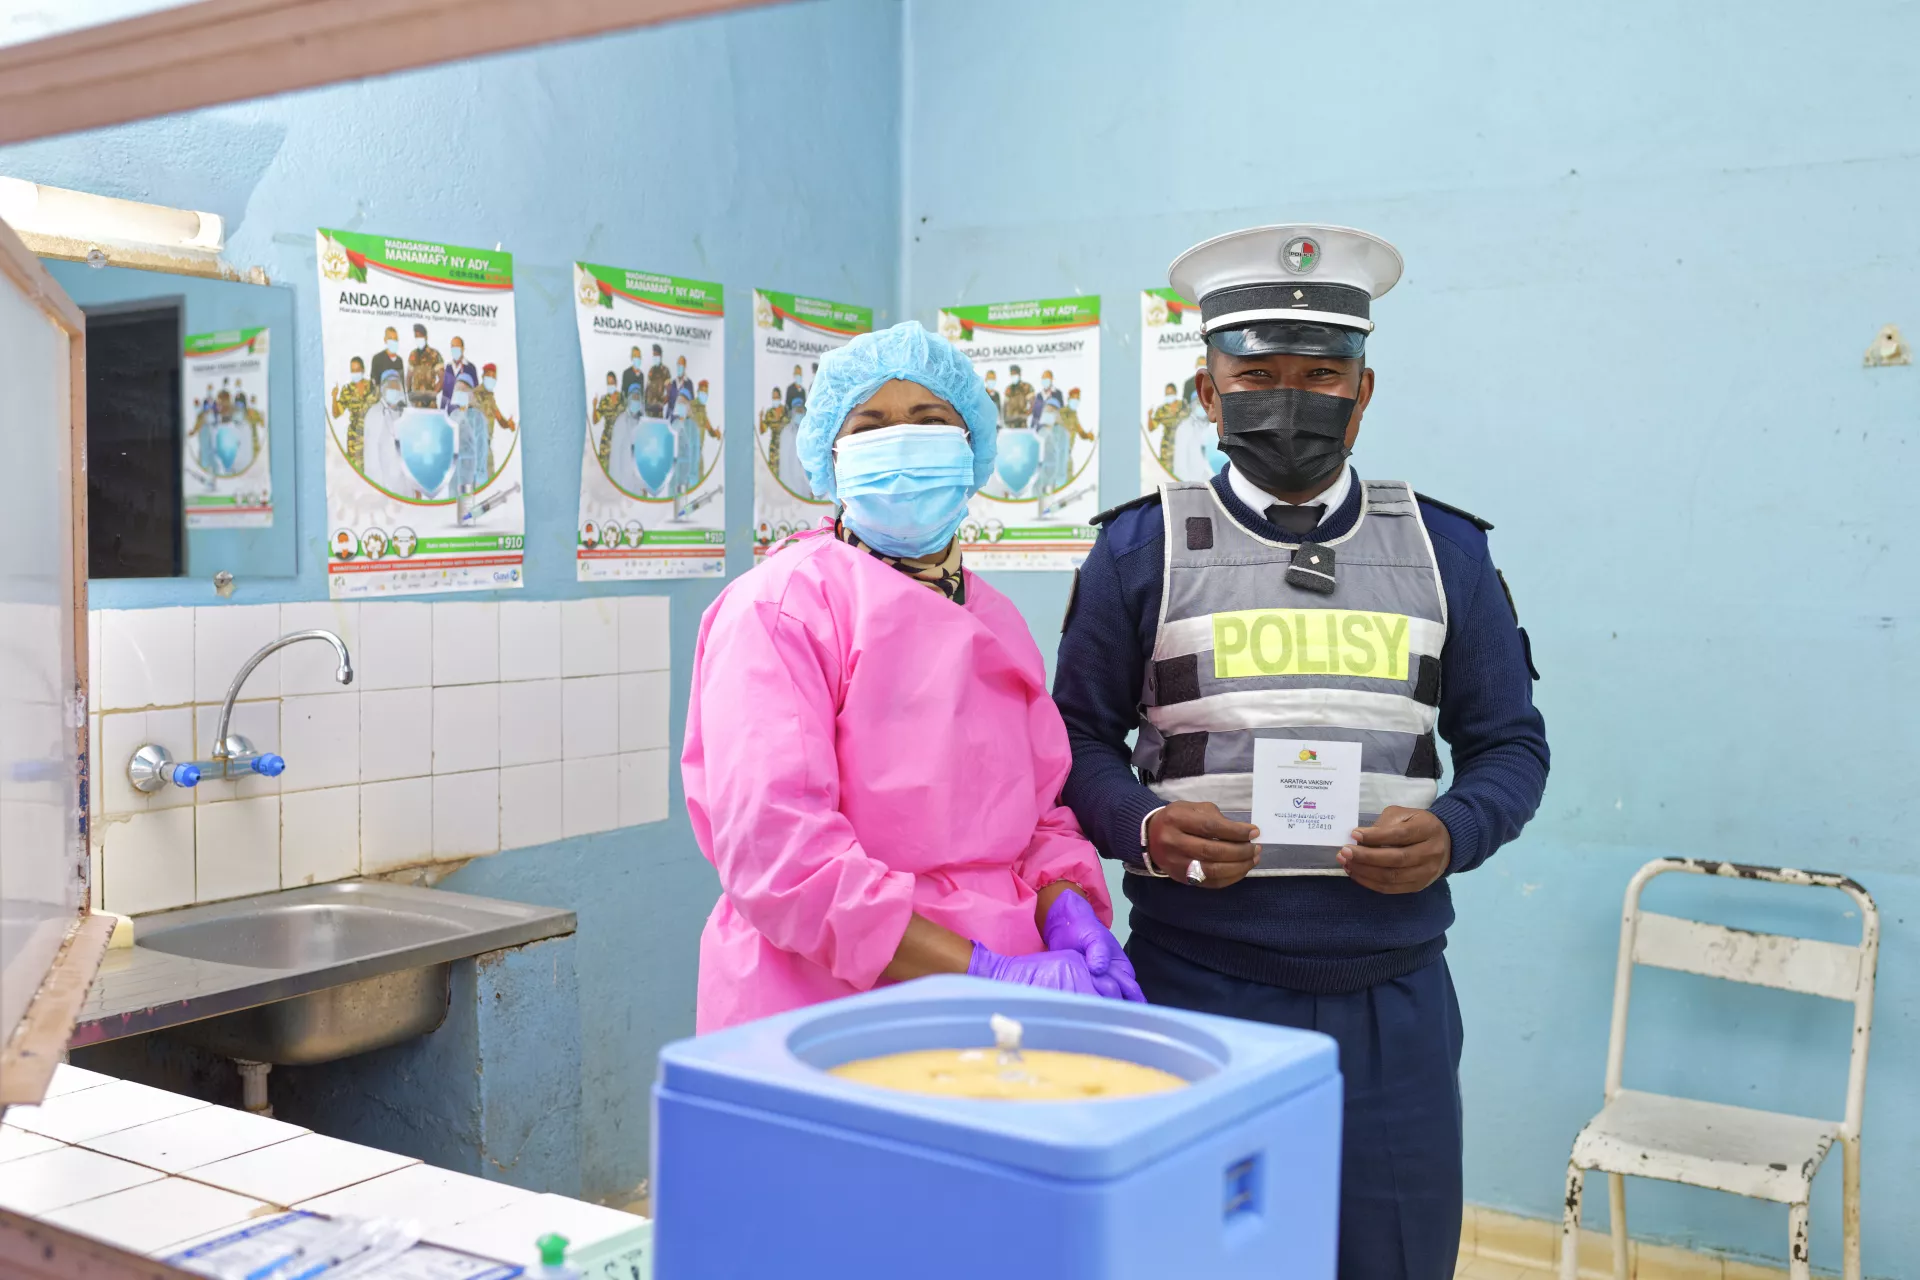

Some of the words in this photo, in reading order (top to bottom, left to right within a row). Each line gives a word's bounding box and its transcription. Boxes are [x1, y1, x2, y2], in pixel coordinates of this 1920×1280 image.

[385, 249, 449, 267] MANAMAFY
[451, 256, 465, 270] NY
[339, 291, 390, 308] ANDAO
[394, 297, 441, 313] HANAO
[444, 302, 499, 318] VAKSINY
[593, 316, 633, 331] ANDAO
[635, 320, 672, 336] HANAO
[674, 325, 713, 340] VAKSINY
[766, 337, 798, 351] ANDAO
[993, 343, 1034, 357] HANAO
[1037, 340, 1085, 354] VAKSINY
[1214, 613, 1409, 677] POLISY
